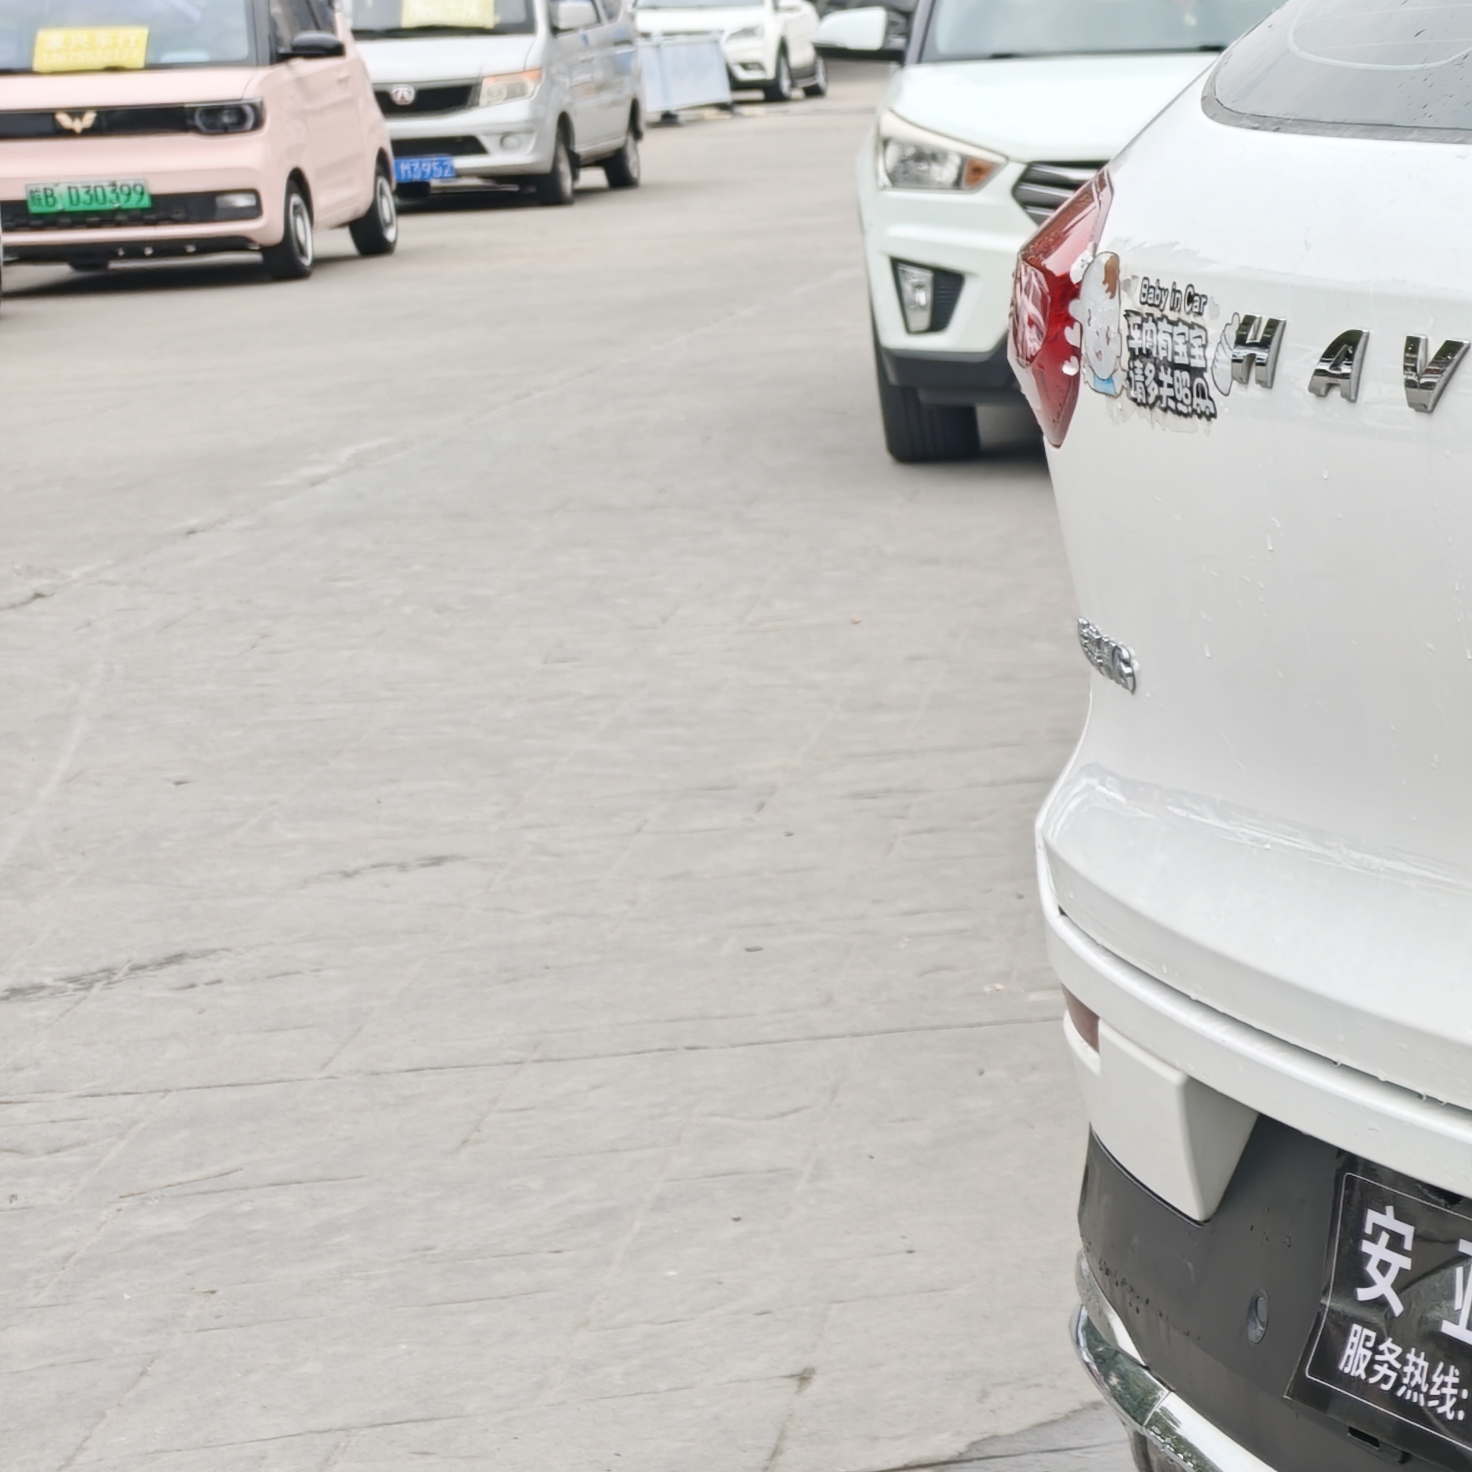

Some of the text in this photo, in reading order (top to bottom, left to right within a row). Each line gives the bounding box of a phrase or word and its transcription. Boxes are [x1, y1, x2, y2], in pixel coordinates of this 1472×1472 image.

[1140, 277, 1208, 316] Baby in Car
[1126, 311, 1208, 368] 车内有宝宝
